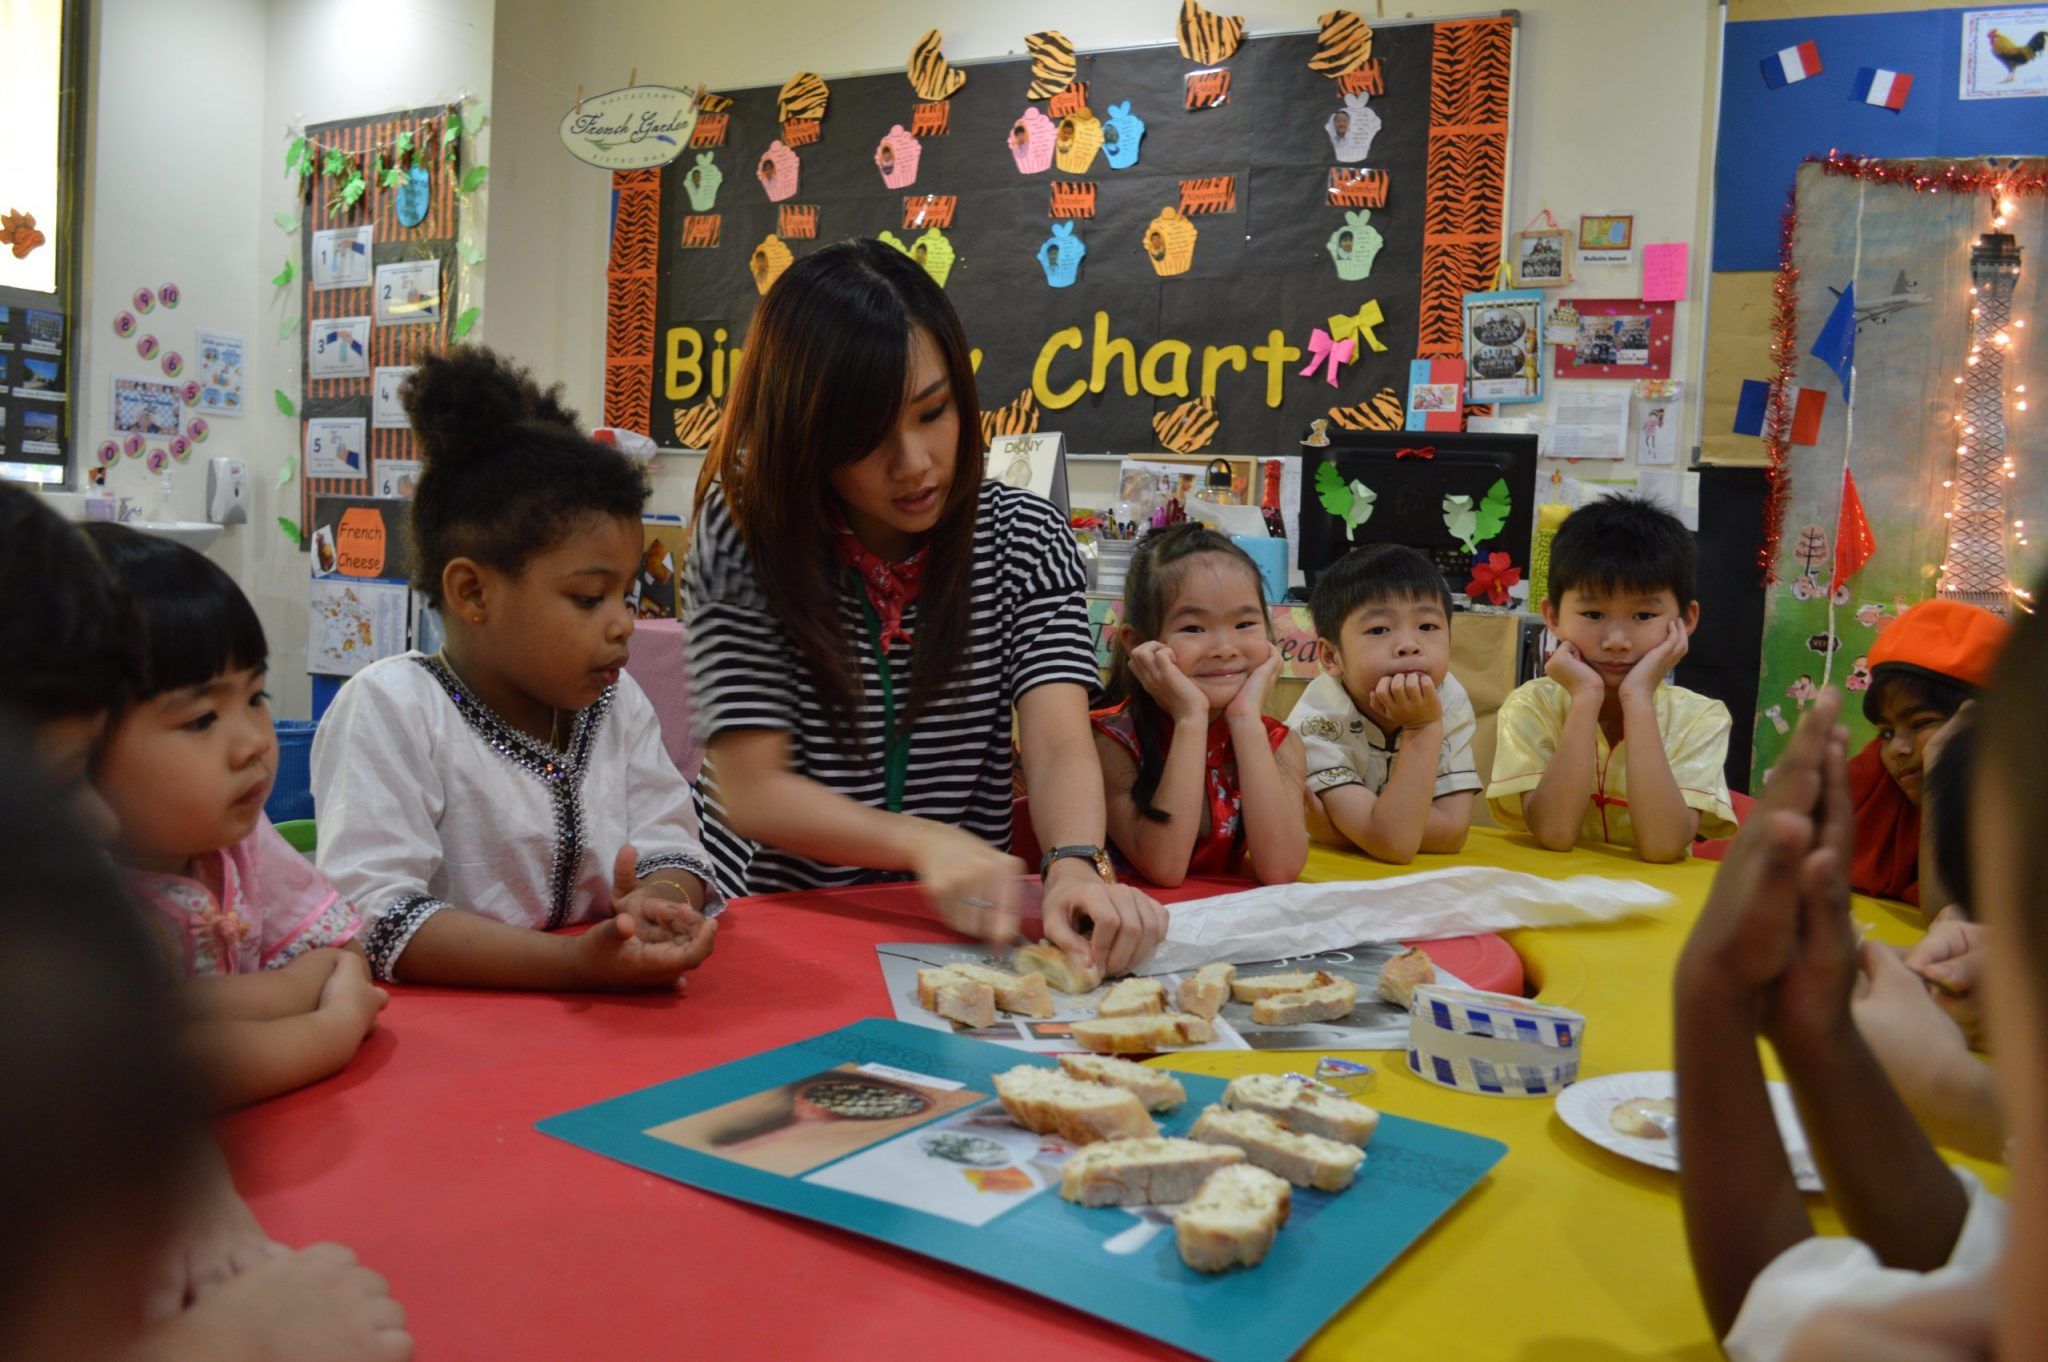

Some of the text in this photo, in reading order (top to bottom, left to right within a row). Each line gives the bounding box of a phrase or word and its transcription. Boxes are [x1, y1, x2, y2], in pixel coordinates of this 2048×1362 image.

[570, 109, 689, 143] French Garden
[321, 250, 327, 264] 1
[141, 293, 149, 306] 9
[163, 288, 177, 303] 10
[383, 285, 392, 300] 2
[121, 317, 130, 332] 8
[145, 338, 153, 353] 7
[317, 339, 325, 354] 3
[169, 357, 177, 371] 6
[1033, 311, 1301, 409] Chart
[187, 385, 196, 400] 5
[381, 387, 389, 402] 4
[194, 422, 202, 436] 4
[132, 439, 138, 452] 1
[177, 440, 185, 454] 3
[313, 438, 321, 453] 5
[1004, 440, 1044, 454] DKNY
[105, 448, 114, 461] 0
[154, 455, 162, 468] 2
[383, 480, 391, 495] 6
[340, 523, 383, 541] French
[337, 552, 381, 570] Cheese
[1272, 637, 1318, 663] rea
